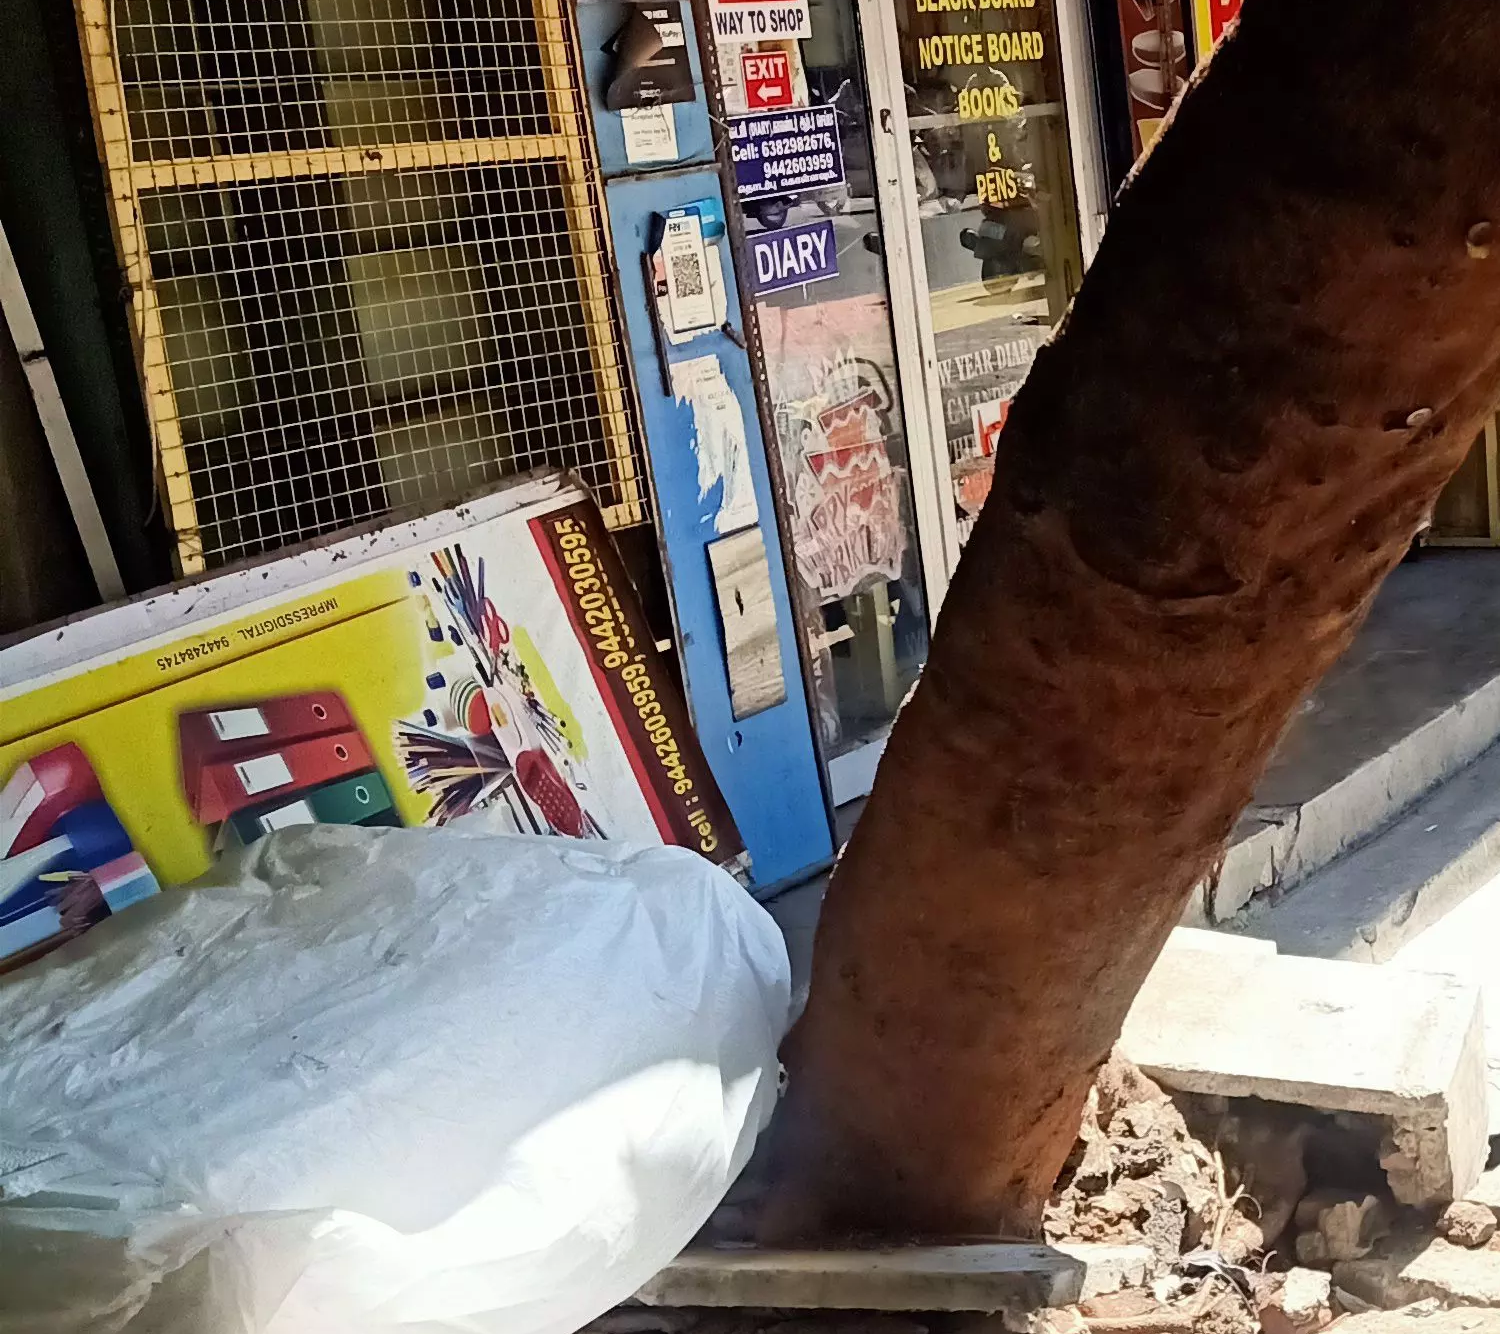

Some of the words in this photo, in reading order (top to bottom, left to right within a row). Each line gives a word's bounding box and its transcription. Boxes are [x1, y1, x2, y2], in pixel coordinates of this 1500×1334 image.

[714, 11, 744, 36] WAY
[747, 10, 767, 34] TO
[770, 8, 804, 33] SHOP
[918, 33, 985, 70] NOTICE
[986, 31, 1044, 63] BOARD
[744, 56, 786, 81] EXIT
[957, 85, 1019, 119] BOOKS
[731, 142, 760, 162] Cell:
[987, 132, 1002, 163] &
[763, 153, 834, 179] 9442603959
[975, 168, 1018, 204] PENS
[754, 228, 829, 284] DIARY
[236, 596, 340, 641] IMPRESSDIGITAL
[156, 635, 231, 672] 9442484745
[686, 807, 719, 854] Cell
